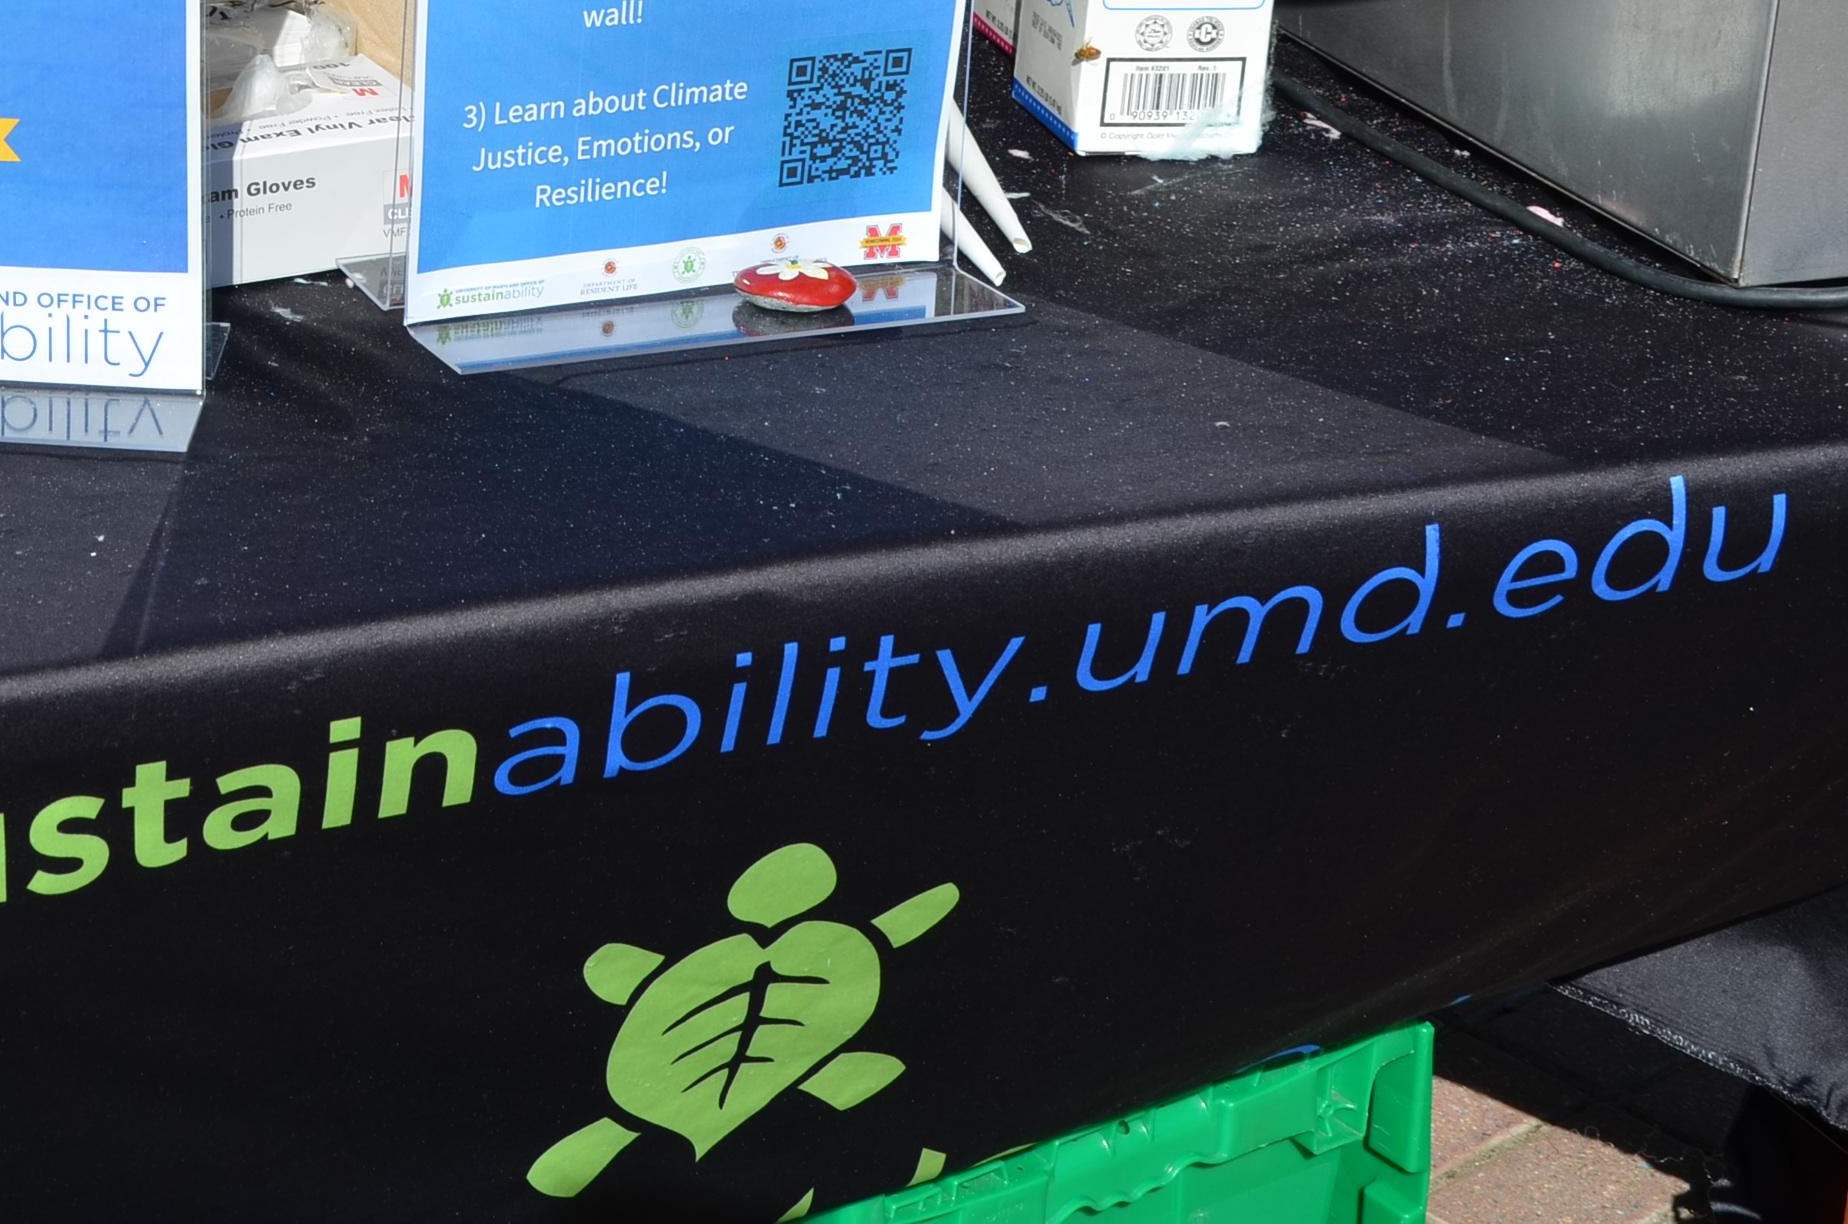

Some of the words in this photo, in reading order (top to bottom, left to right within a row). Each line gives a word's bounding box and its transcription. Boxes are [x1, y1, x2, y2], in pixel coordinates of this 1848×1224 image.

[583, 0, 644, 28] wall!
[463, 102, 486, 132] 3)
[494, 100, 565, 125] Learn
[572, 90, 647, 118] about
[653, 79, 748, 108] Climate
[239, 128, 302, 144] Exam
[308, 119, 363, 135] Vinyl
[205, 141, 234, 151] Gl
[472, 141, 569, 172] Justice,
[577, 128, 701, 160] Emotions,
[708, 125, 735, 145] or
[246, 176, 316, 197] Gloves
[535, 171, 668, 208] Resilience!
[227, 205, 265, 219] Protein
[268, 201, 292, 213] Free
[455, 285, 544, 305] sustainability
[580, 285, 622, 296] RESIDENT
[624, 283, 638, 292] LIFE
[37, 291, 126, 312] OFFICE
[133, 296, 167, 314] OF
